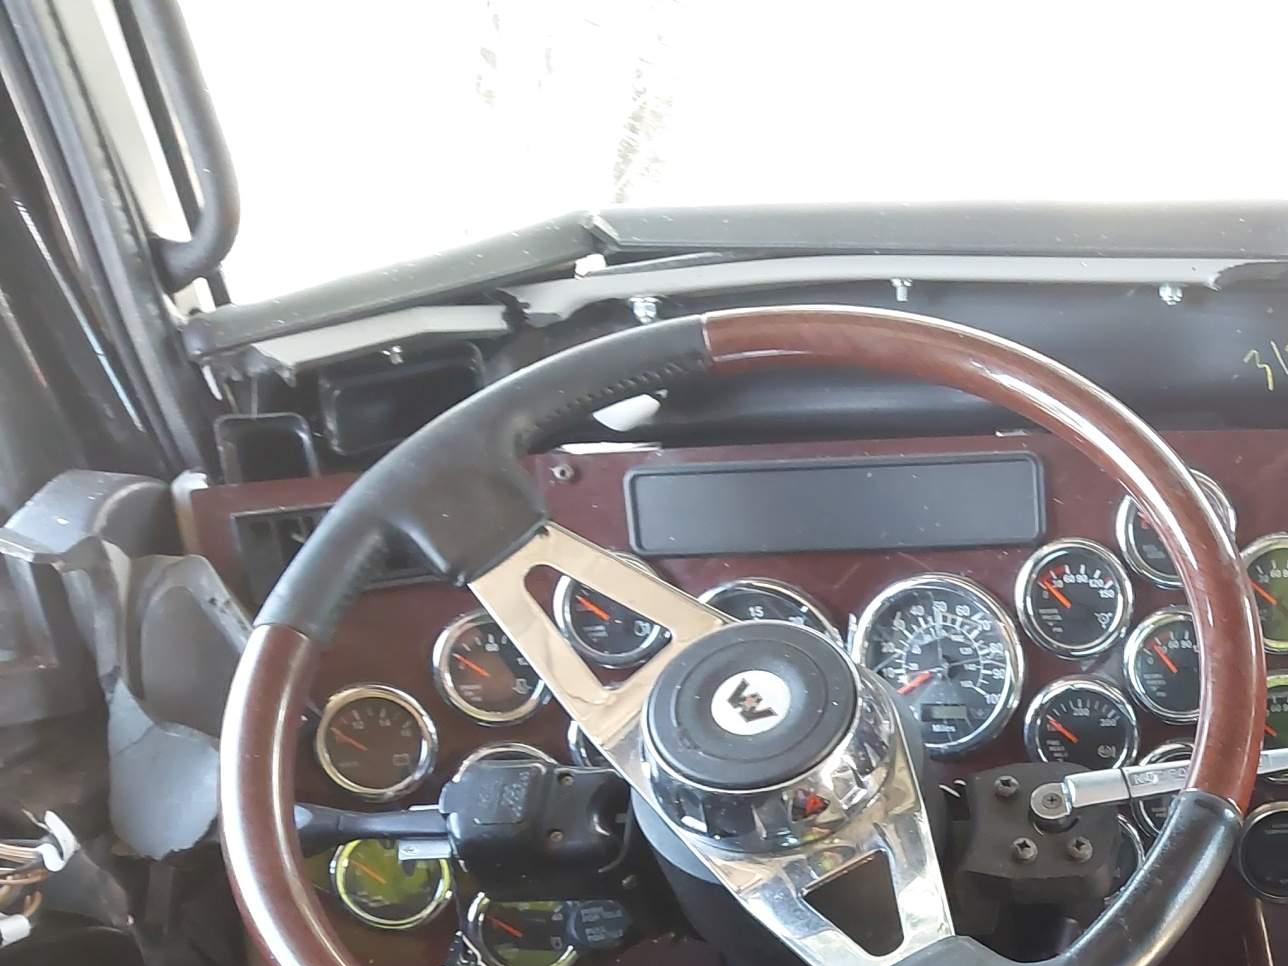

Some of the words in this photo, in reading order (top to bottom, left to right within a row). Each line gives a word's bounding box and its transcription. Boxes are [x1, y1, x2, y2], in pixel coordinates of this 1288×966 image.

[1088, 578, 1105, 588] 120
[1099, 589, 1115, 598] 150
[748, 606, 764, 618] 15
